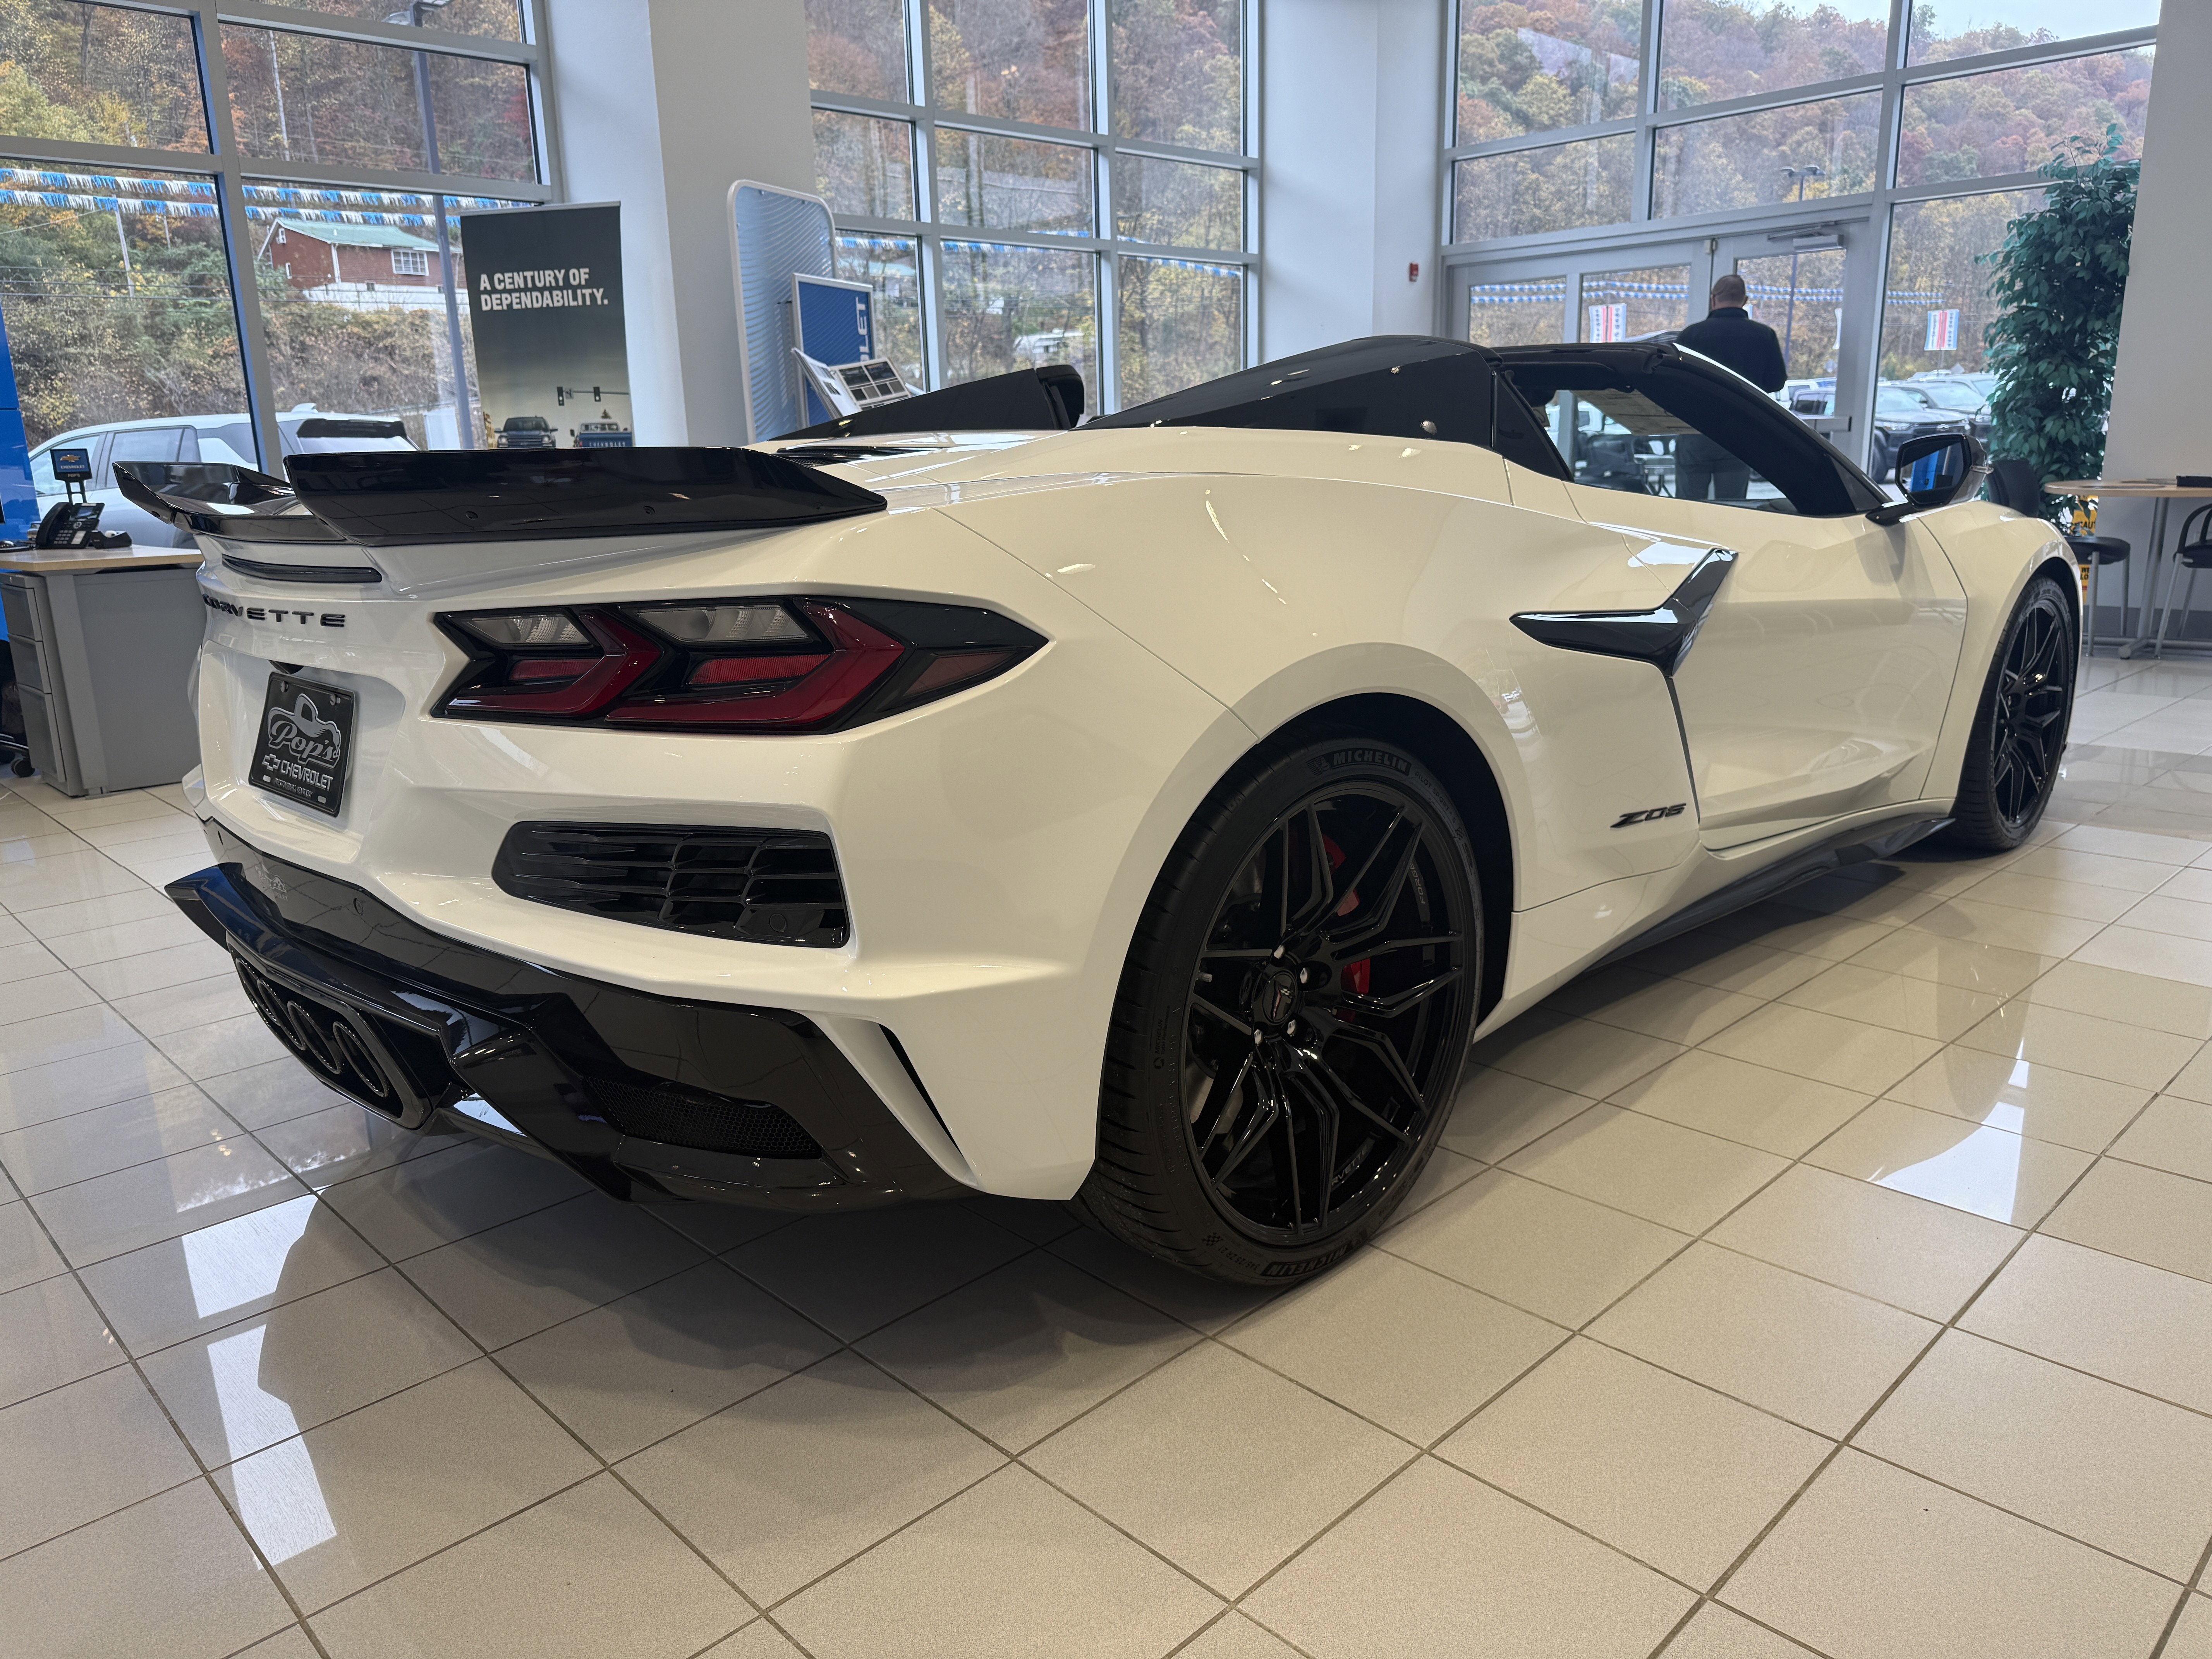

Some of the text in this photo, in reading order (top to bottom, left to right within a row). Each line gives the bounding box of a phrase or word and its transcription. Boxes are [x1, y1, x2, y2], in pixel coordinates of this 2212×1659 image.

[480, 268, 589, 291] A CENTURY OF
[481, 288, 608, 311] DEPENDABILITY.
[202, 594, 345, 627] CORVETTE
[271, 720, 335, 762] Pop's
[280, 760, 333, 790] CHEVROLET
[1332, 750, 1408, 773] MICHELIN
[1414, 771, 1432, 788] PILOT
[1432, 787, 1450, 811] SPORT
[1610, 803, 1686, 828] Z06
[1409, 863, 1426, 904] FORGE
[1155, 1019, 1163, 1054] MICHELIN
